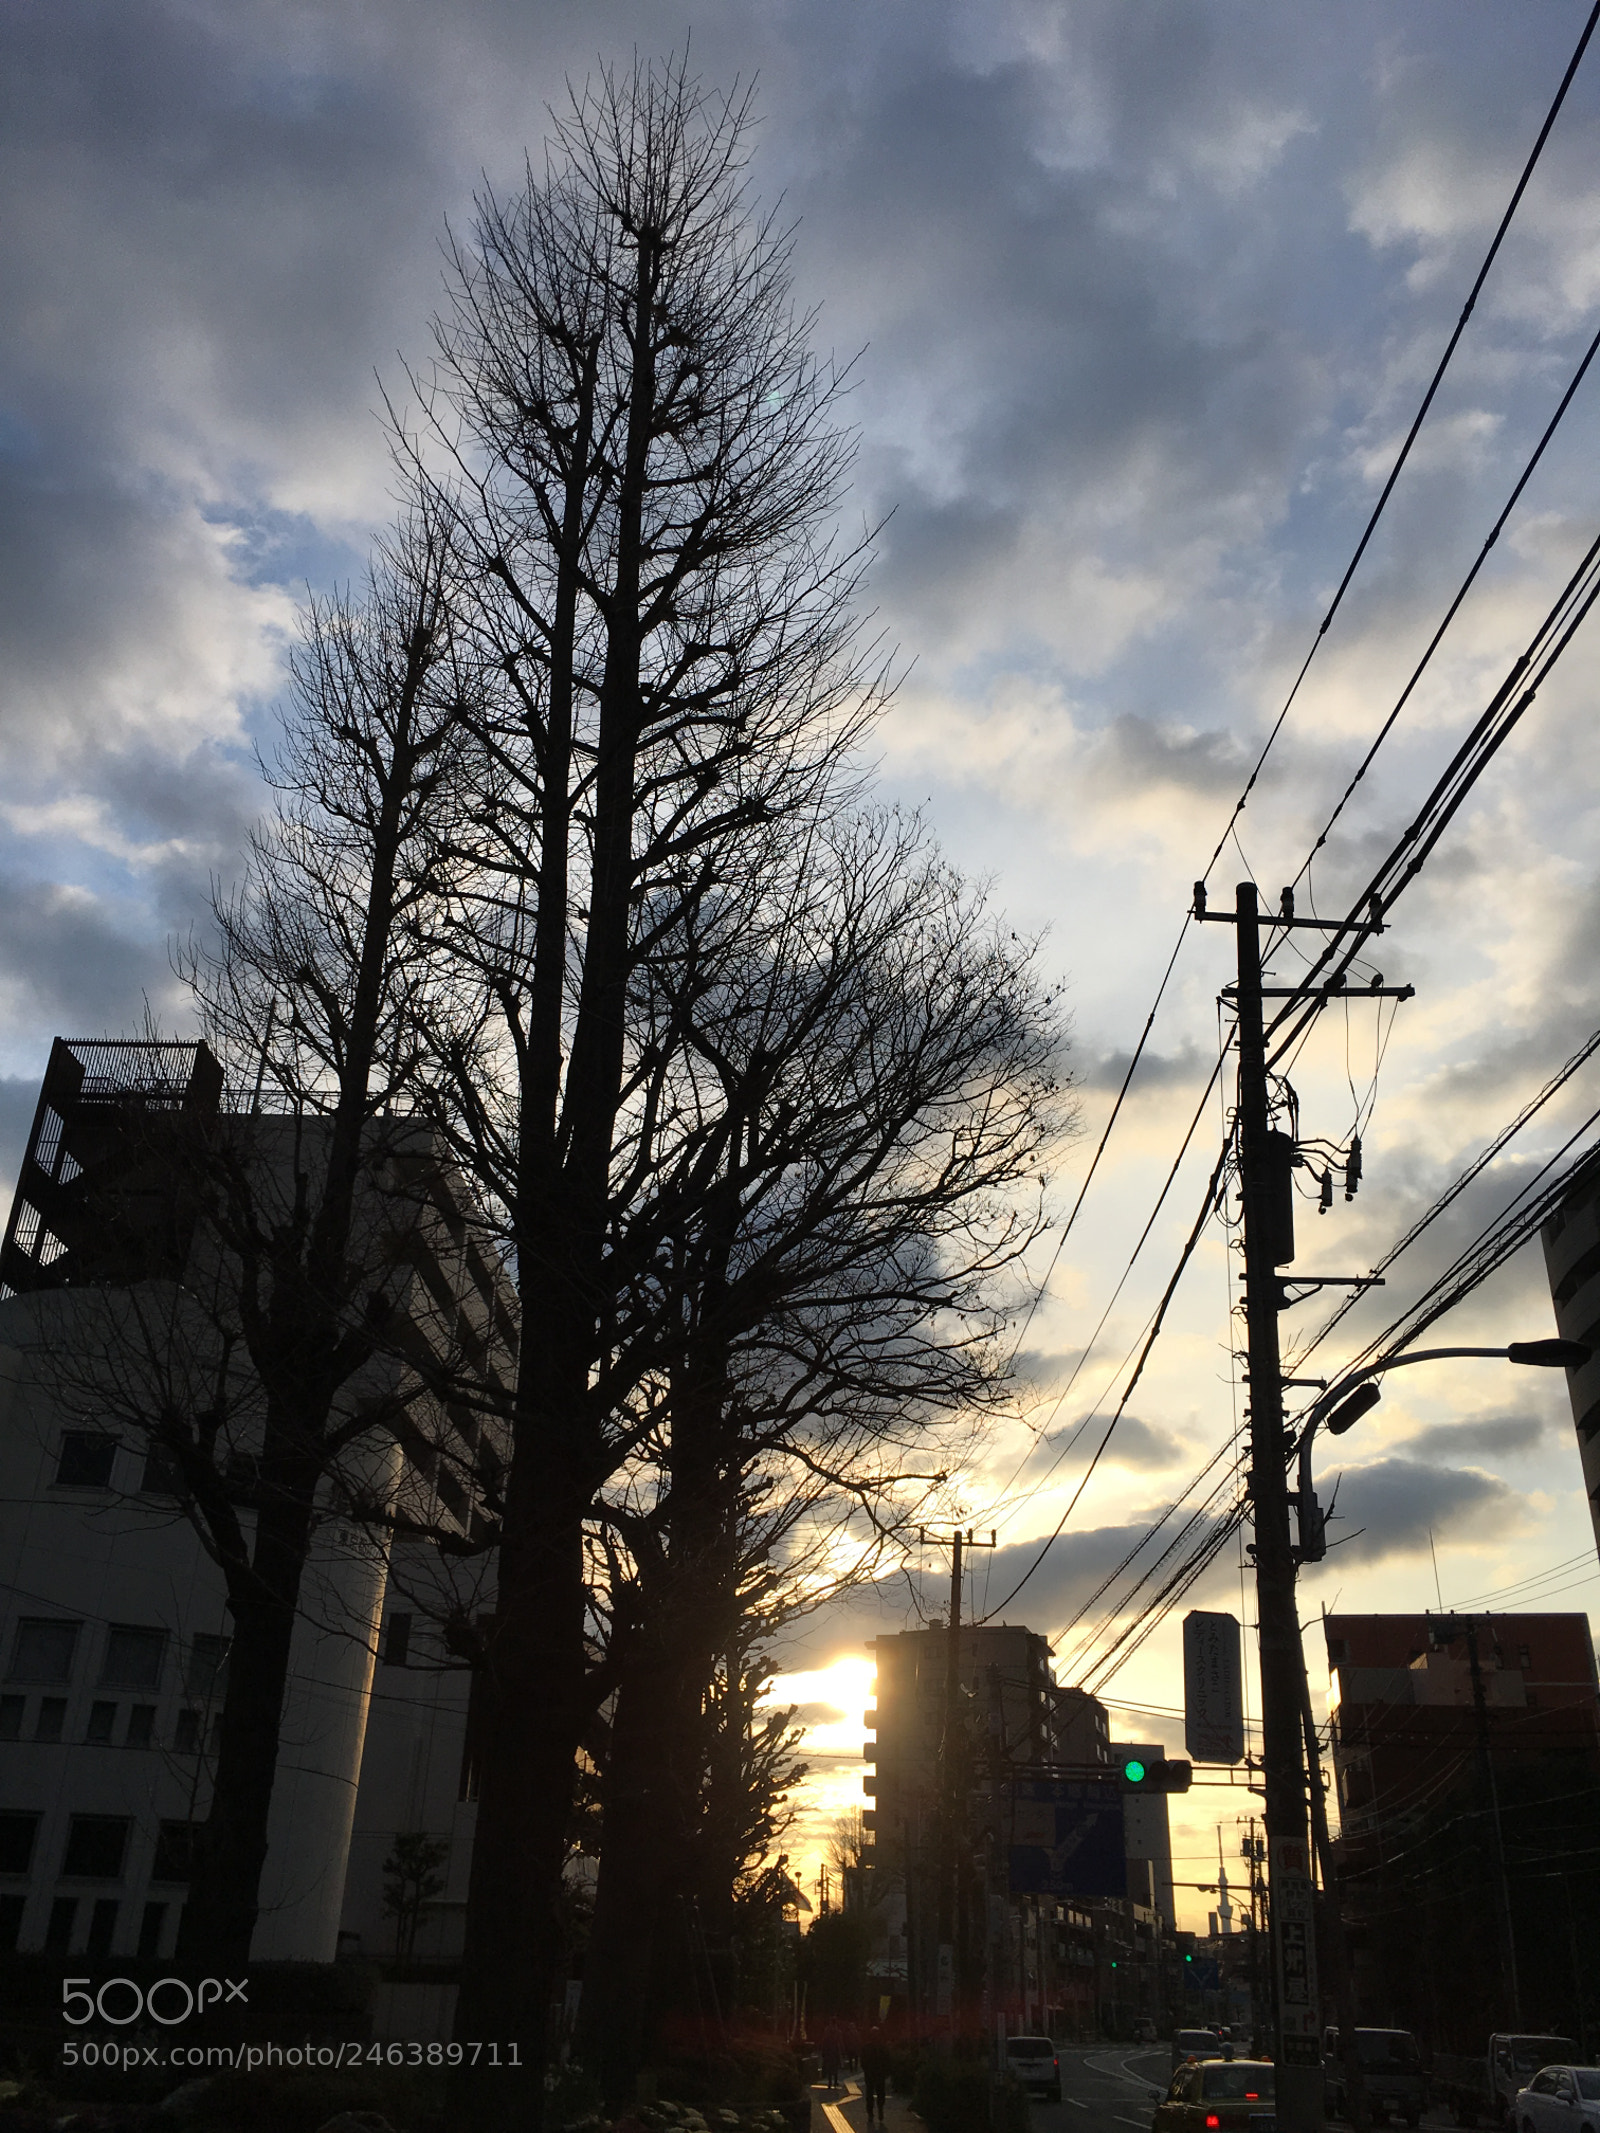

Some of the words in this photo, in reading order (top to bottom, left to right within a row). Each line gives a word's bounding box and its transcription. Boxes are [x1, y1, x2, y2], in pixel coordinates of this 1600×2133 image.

[1193, 1620, 1207, 1719] レディースクリニック
[1283, 1844, 1304, 1870] 質
